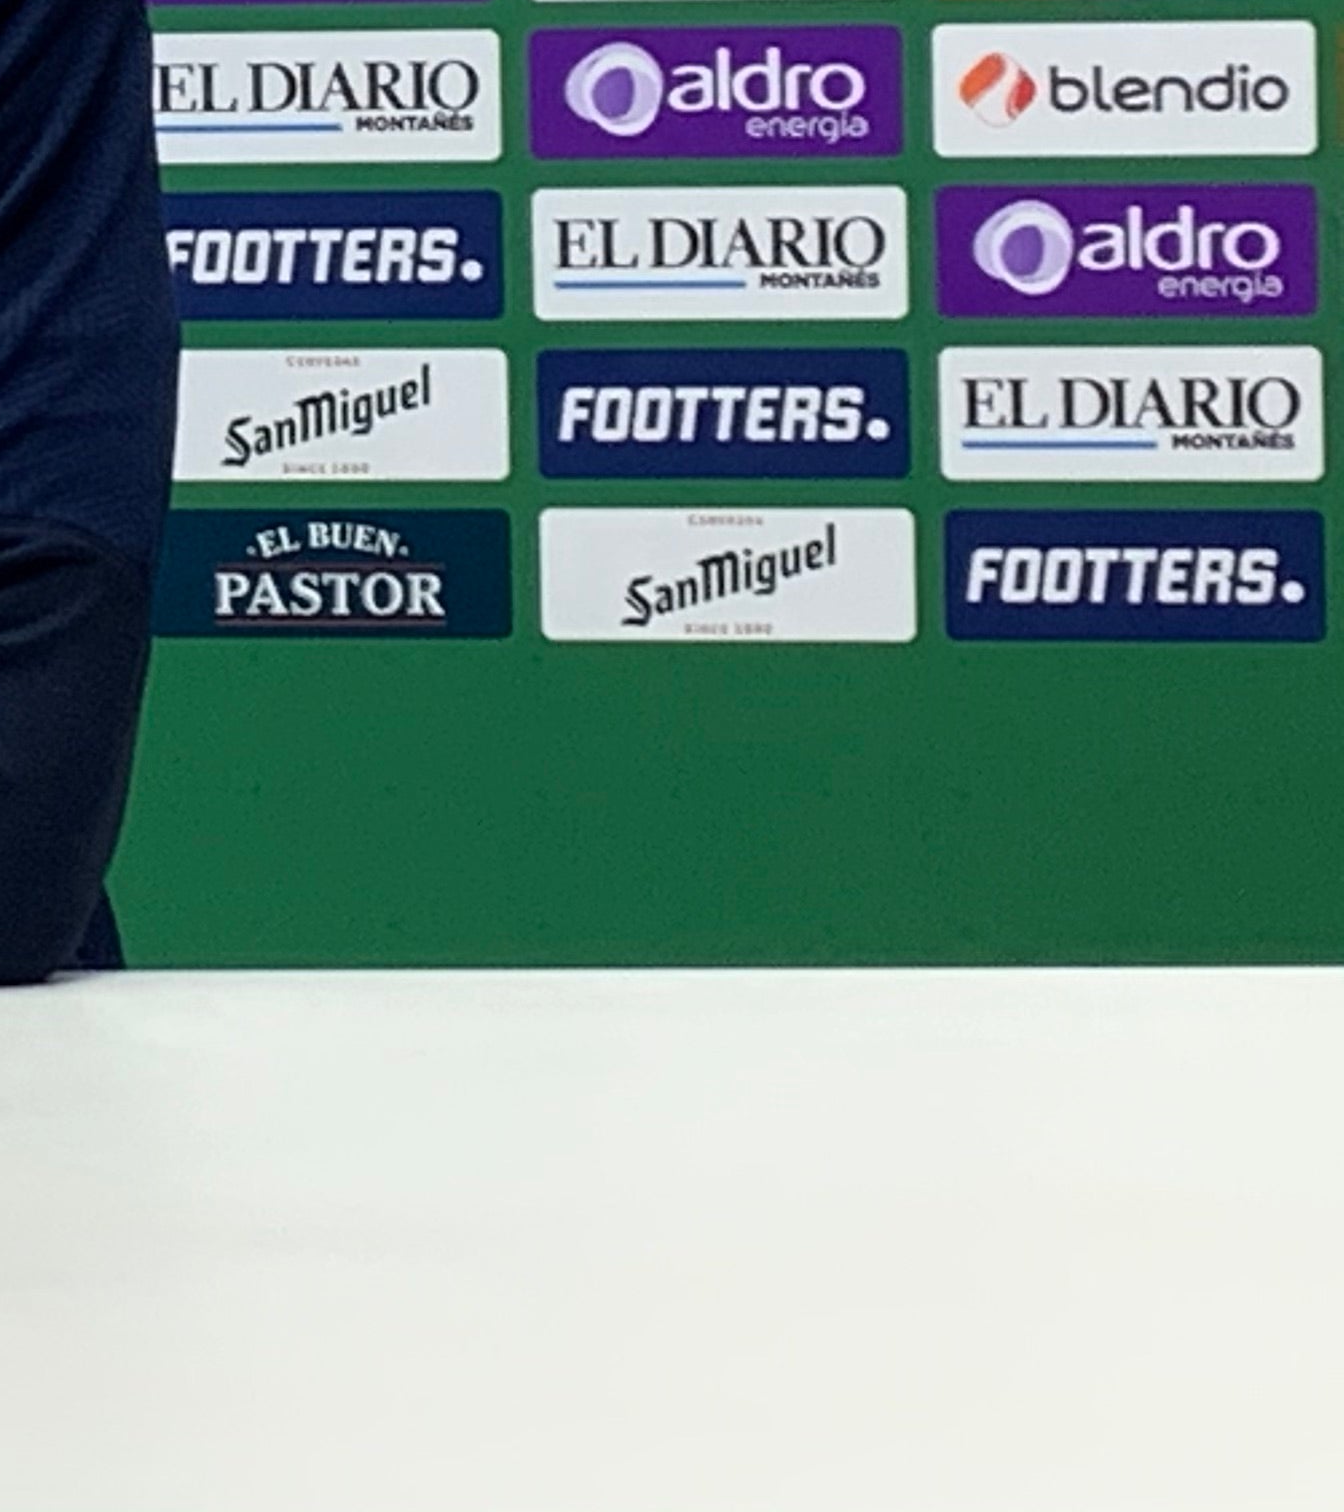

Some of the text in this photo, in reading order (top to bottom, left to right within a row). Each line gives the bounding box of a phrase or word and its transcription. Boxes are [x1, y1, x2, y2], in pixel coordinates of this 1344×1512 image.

[1048, 63, 1290, 114] blendio
[1077, 204, 1280, 271] aldro
[962, 376, 1302, 434] EL DIARIO
[255, 521, 402, 559] EL BUEN
[214, 571, 446, 617] PASTOR
